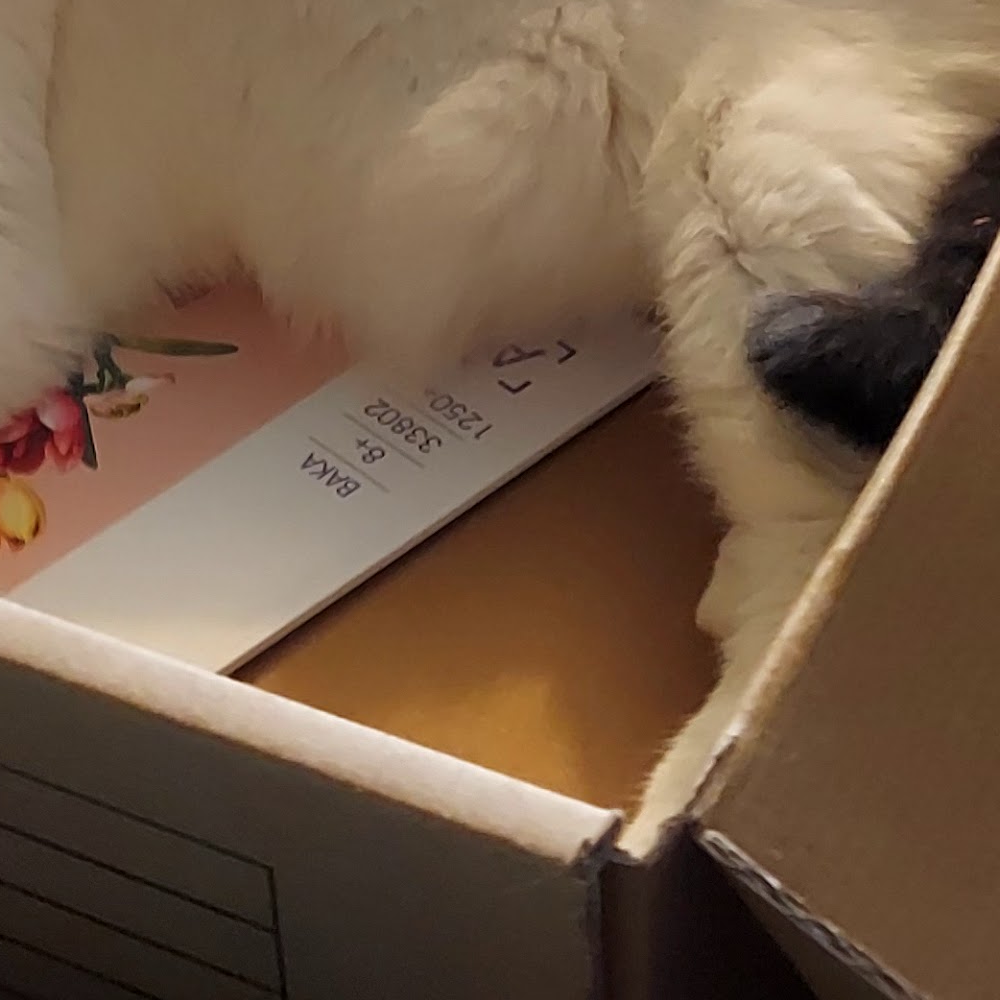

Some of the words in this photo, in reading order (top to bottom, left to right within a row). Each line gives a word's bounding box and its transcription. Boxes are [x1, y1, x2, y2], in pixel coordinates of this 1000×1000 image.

[363, 397, 443, 454] 33802
[356, 436, 386, 465] 8+
[300, 452, 362, 499] BAKA
